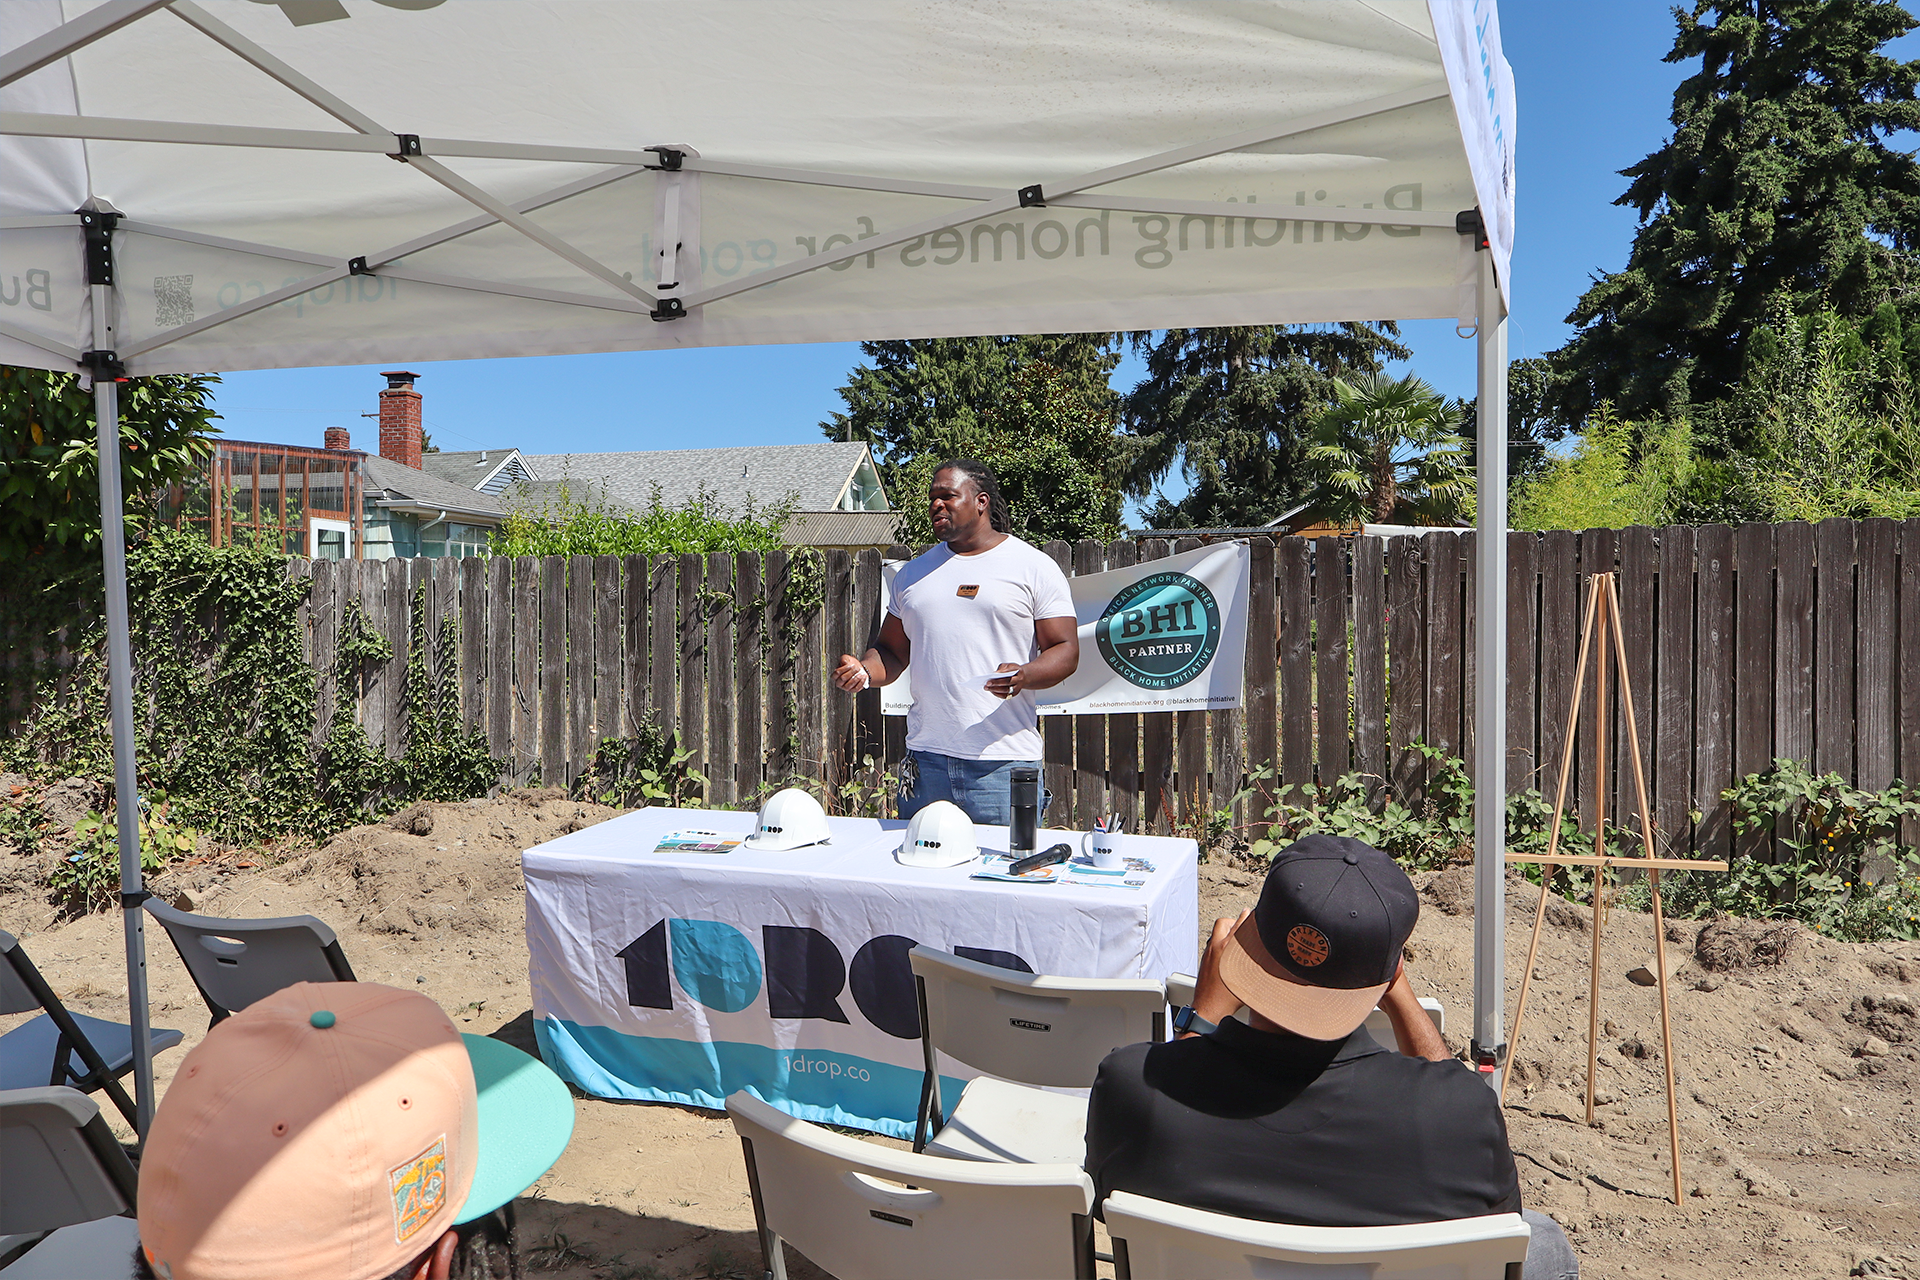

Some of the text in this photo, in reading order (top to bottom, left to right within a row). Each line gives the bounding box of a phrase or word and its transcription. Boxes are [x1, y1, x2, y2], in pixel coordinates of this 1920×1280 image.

[1131, 575, 1179, 594] NETWORK
[1180, 577, 1214, 610] PARTNER
[1121, 599, 1197, 638] BHI
[1128, 642, 1193, 658] PARTNER
[1109, 646, 1212, 687] BLACK HOME INITIATIVE
[1089, 695, 1235, 709] blackhomeinitiative.org @blackhomeinitiative
[1291, 927, 1327, 951] BRIXTON
[1288, 942, 1322, 966] SUPPLY
[1014, 1020, 1046, 1030] LIFETIME
[783, 1054, 871, 1083] 1drop.co
